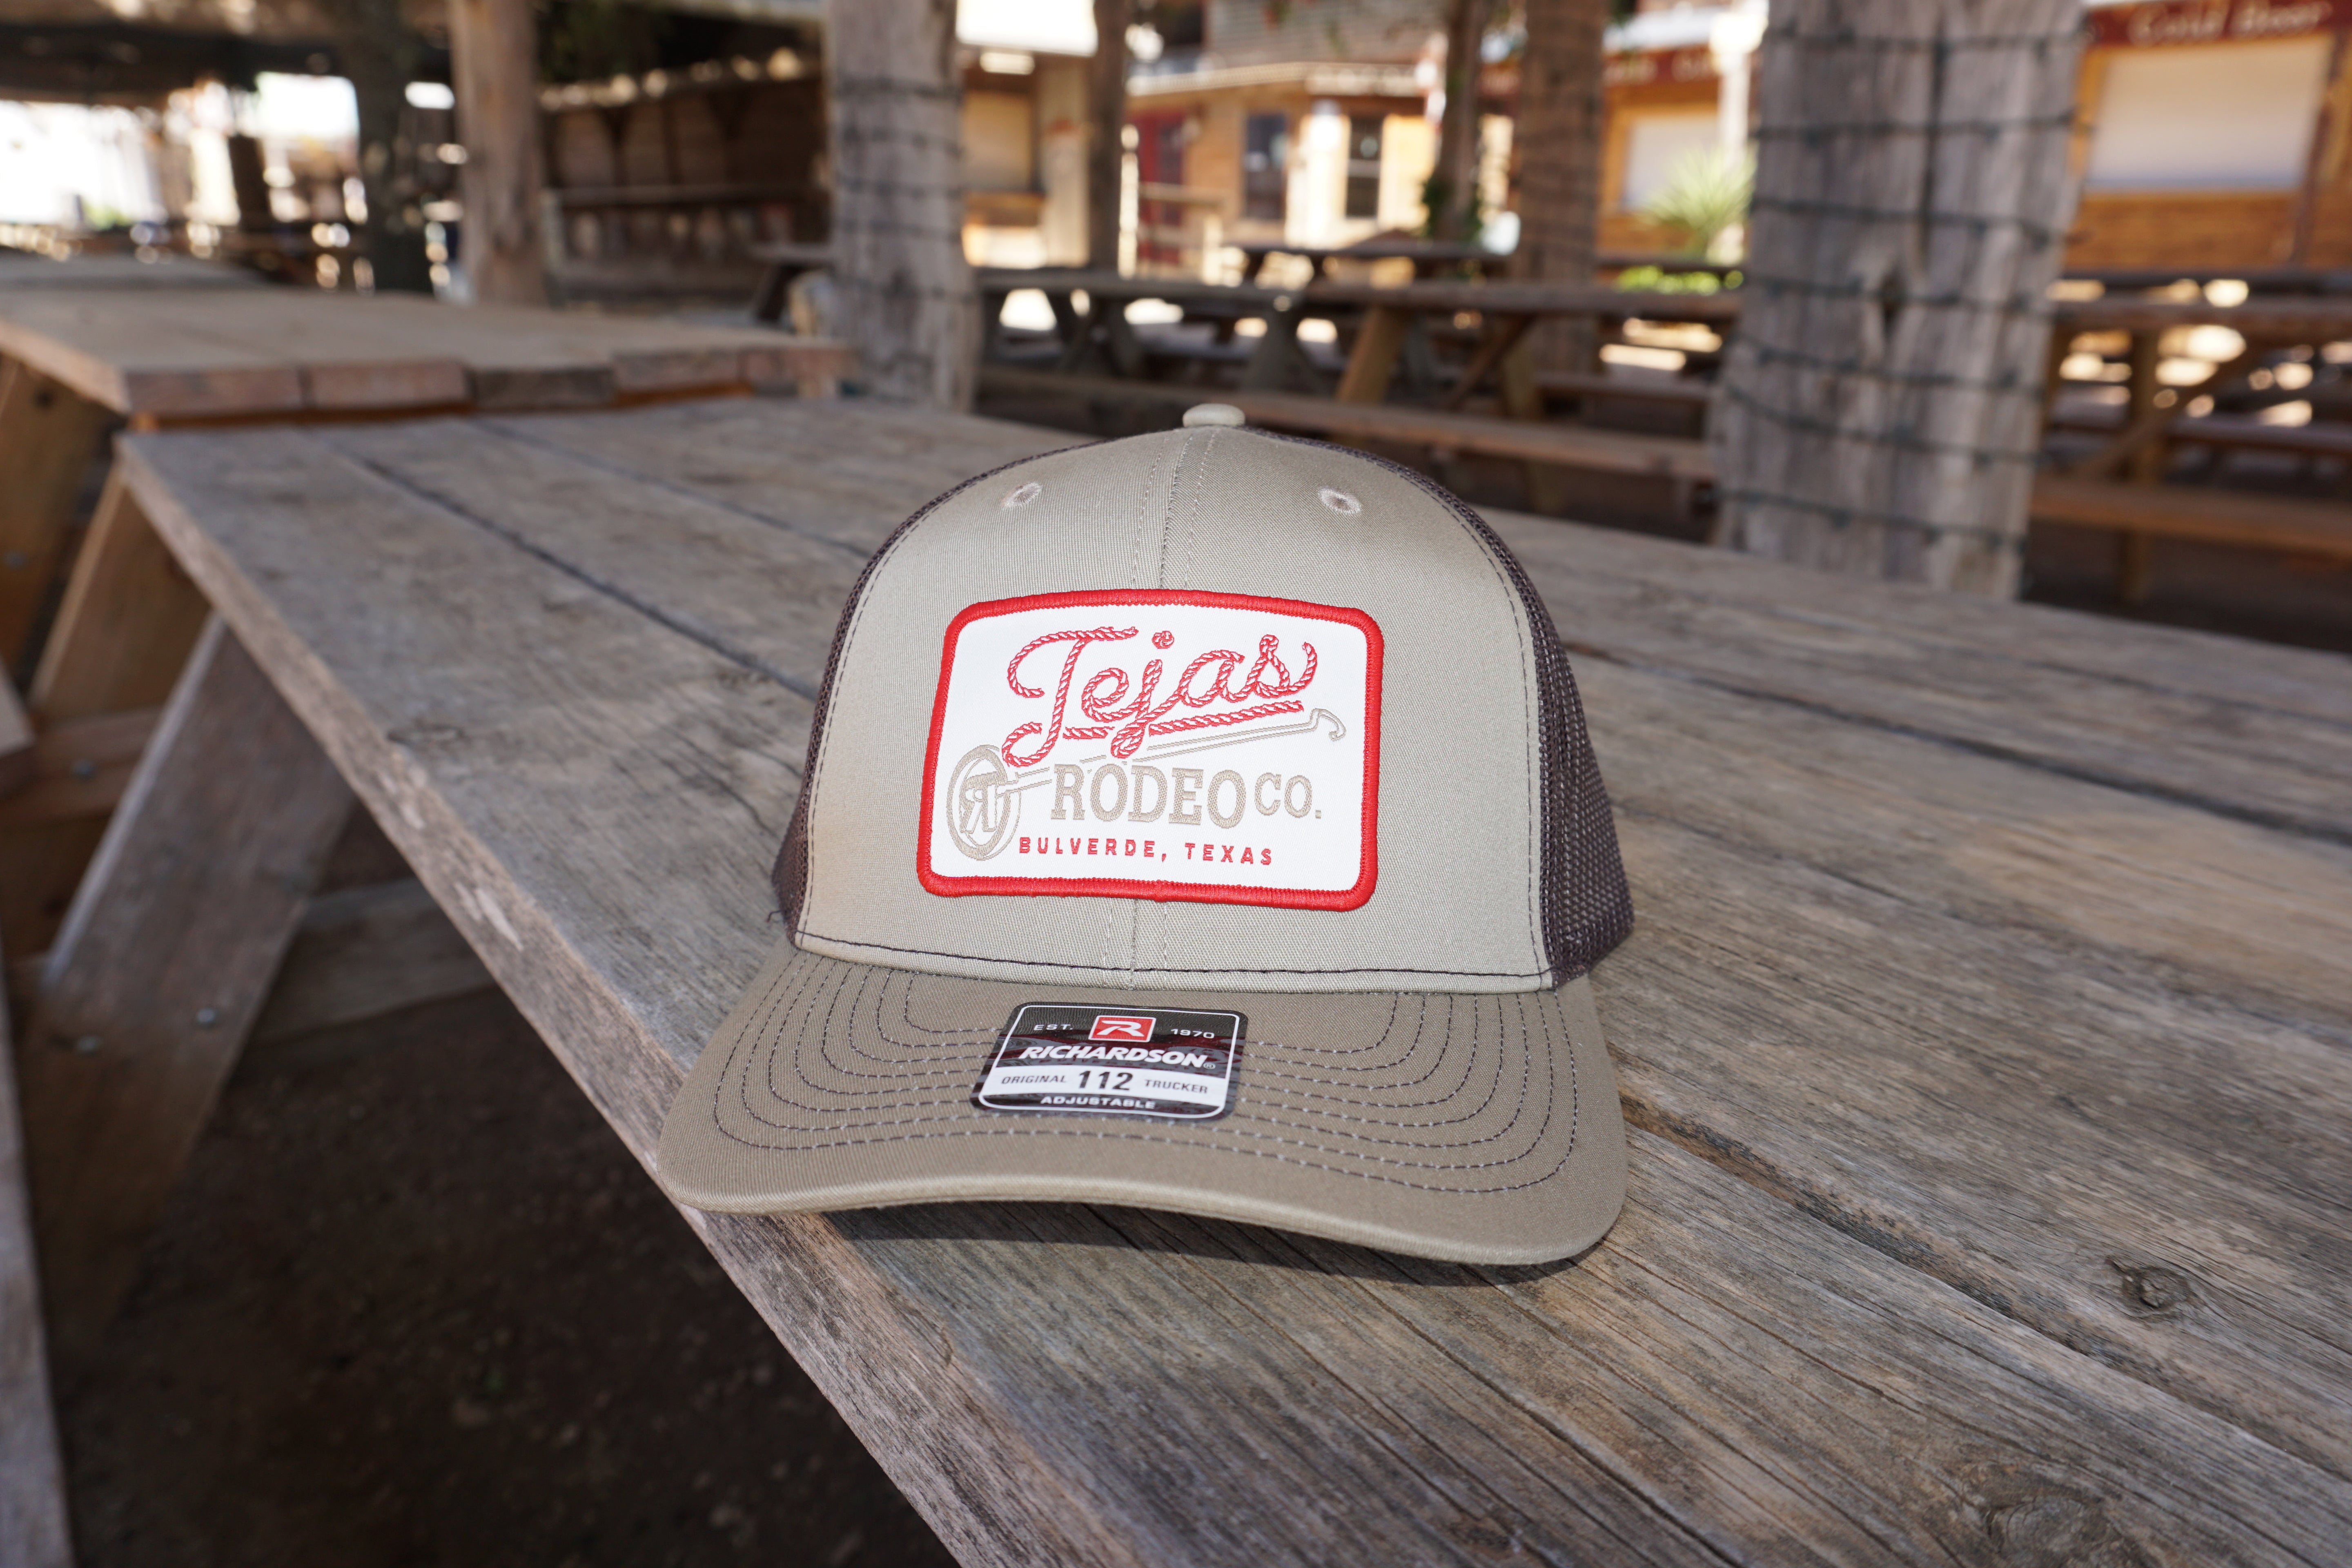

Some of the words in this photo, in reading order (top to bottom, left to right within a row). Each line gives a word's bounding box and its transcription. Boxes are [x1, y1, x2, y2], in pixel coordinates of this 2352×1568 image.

[1002, 626, 1317, 767] Tejas
[1051, 764, 1247, 829] RODEO
[1254, 772, 1321, 819] CO.
[1019, 837, 1167, 862] BULVERDE,
[1185, 842, 1272, 865] TEXAS
[1170, 1028, 1215, 1039] 1970
[1001, 1075, 1066, 1085] ORIGINAL
[1078, 1071, 1134, 1091] 112
[1145, 1079, 1208, 1094] TRUCKER
[1040, 1096, 1156, 1109] ADJUSTABLE
